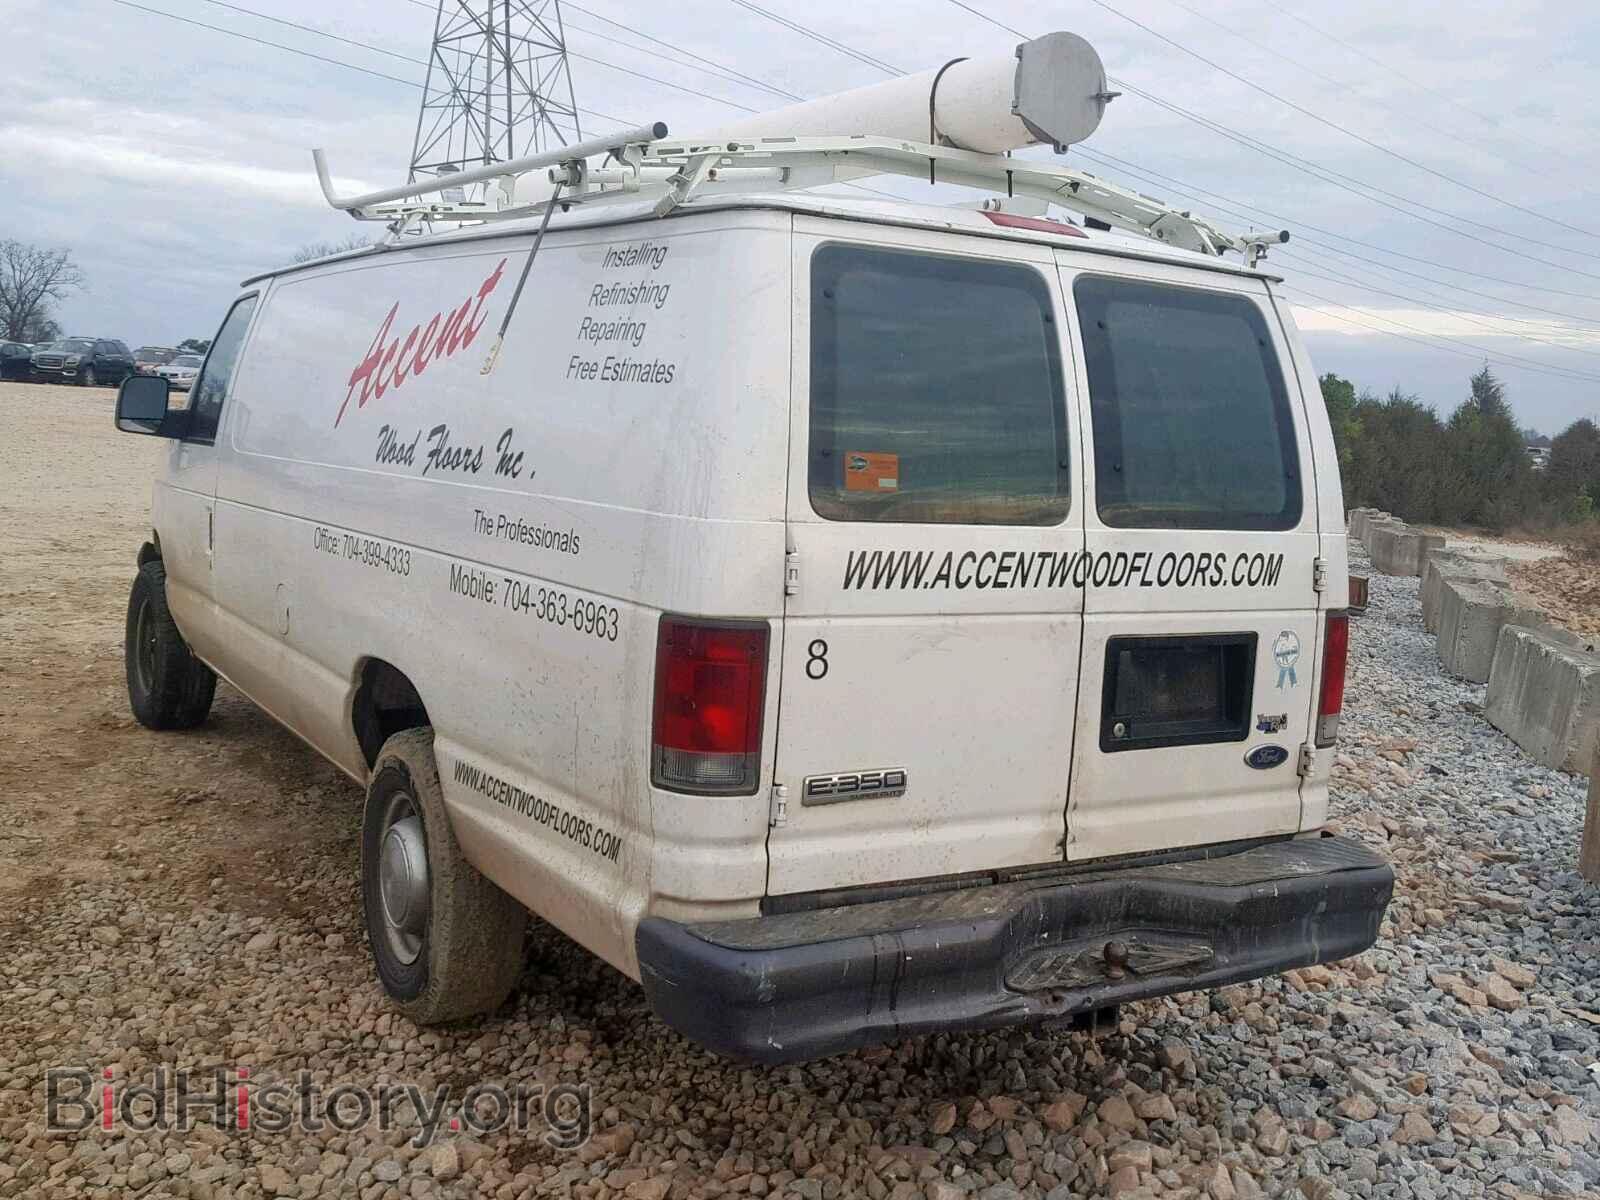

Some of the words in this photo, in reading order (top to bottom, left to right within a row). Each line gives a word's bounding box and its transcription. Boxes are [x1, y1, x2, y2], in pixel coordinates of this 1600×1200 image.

[602, 241, 668, 270] Installing
[588, 279, 671, 310] Refinishing
[334, 257, 507, 429] Accent
[578, 315, 646, 348] Repairing
[566, 355, 598, 380] Free
[600, 356, 675, 383] Estimates
[376, 424, 421, 466] Wood
[422, 423, 483, 476] Floors
[313, 526, 341, 555] Office:
[342, 534, 411, 576] 704-399-4333
[473, 509, 494, 536] The
[496, 514, 581, 556] Professionals
[842, 550, 1284, 591] WWW.ACCENTWOODFLOORS.COM
[450, 563, 498, 606] Mobile:
[502, 578, 620, 642] 704-363-6963
[805, 639, 829, 680] 8
[454, 759, 622, 865] WWW.ACCENTWOODFLOORS.COM
